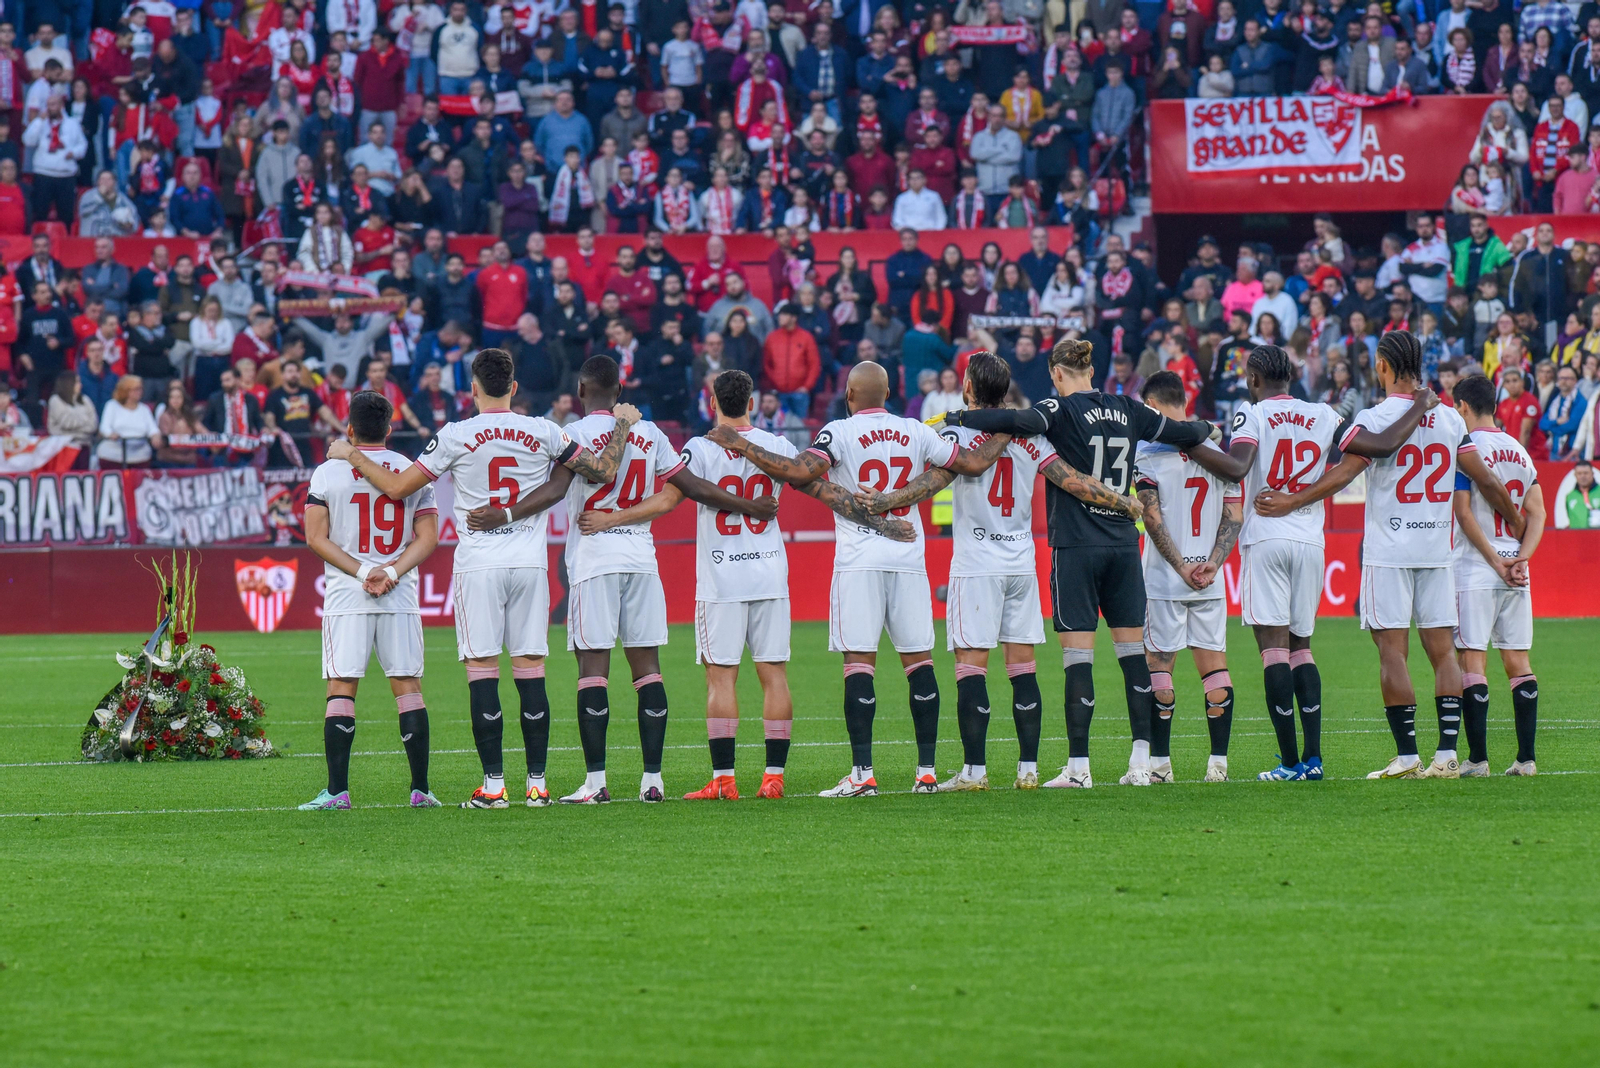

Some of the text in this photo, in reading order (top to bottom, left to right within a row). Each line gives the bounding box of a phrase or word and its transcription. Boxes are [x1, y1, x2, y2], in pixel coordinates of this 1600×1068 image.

[464, 428, 541, 453] L.OCAMPOS
[858, 428, 910, 449] MARCAO
[1084, 407, 1128, 426] NYLAND
[488, 456, 520, 510] 5
[584, 459, 647, 513] 24
[988, 457, 1015, 517] 4
[1088, 435, 1130, 494] 13
[1266, 439, 1321, 493] 42
[1396, 443, 1451, 503] 22
[350, 493, 405, 555] 19
[716, 473, 773, 536] 20
[1184, 477, 1209, 537] 7
